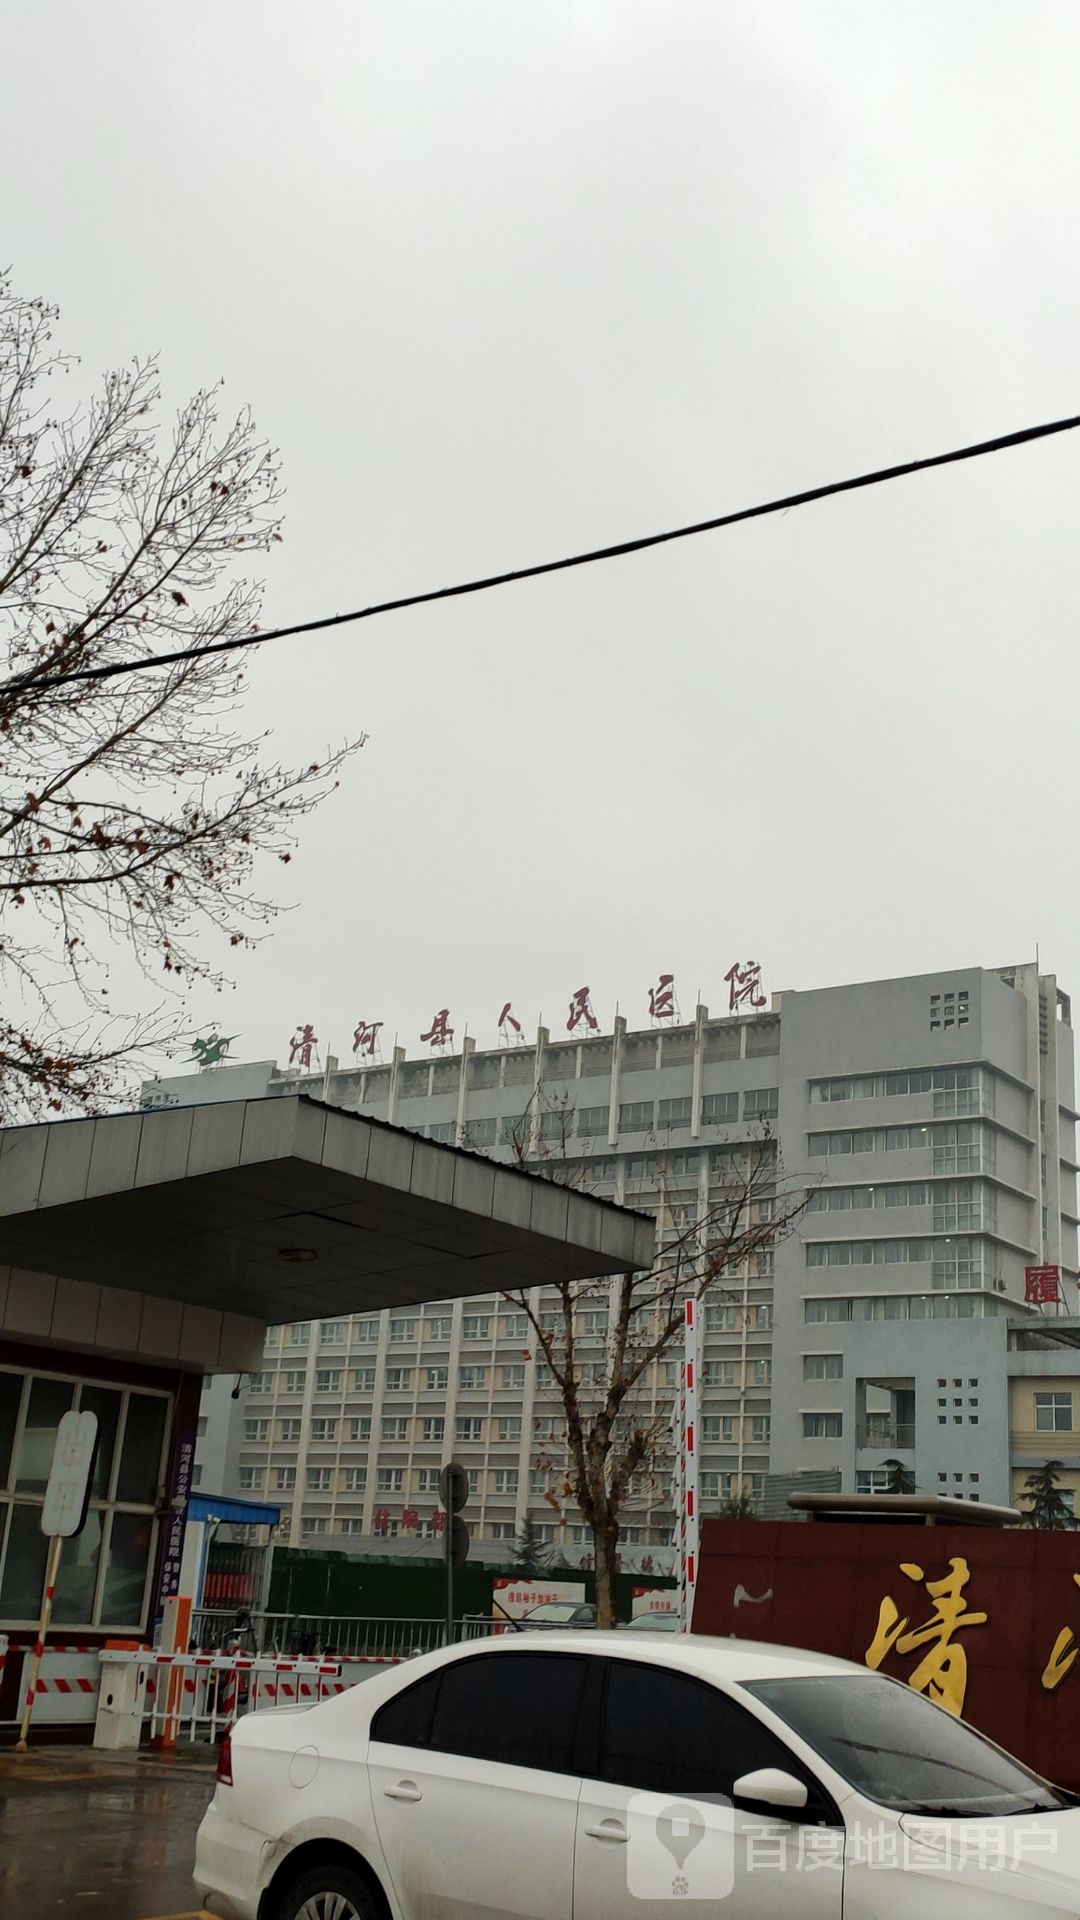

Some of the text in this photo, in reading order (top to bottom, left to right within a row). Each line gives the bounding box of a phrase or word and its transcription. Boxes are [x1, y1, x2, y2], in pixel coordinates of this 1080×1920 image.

[289, 961, 767, 1067] 清河县人民医院
